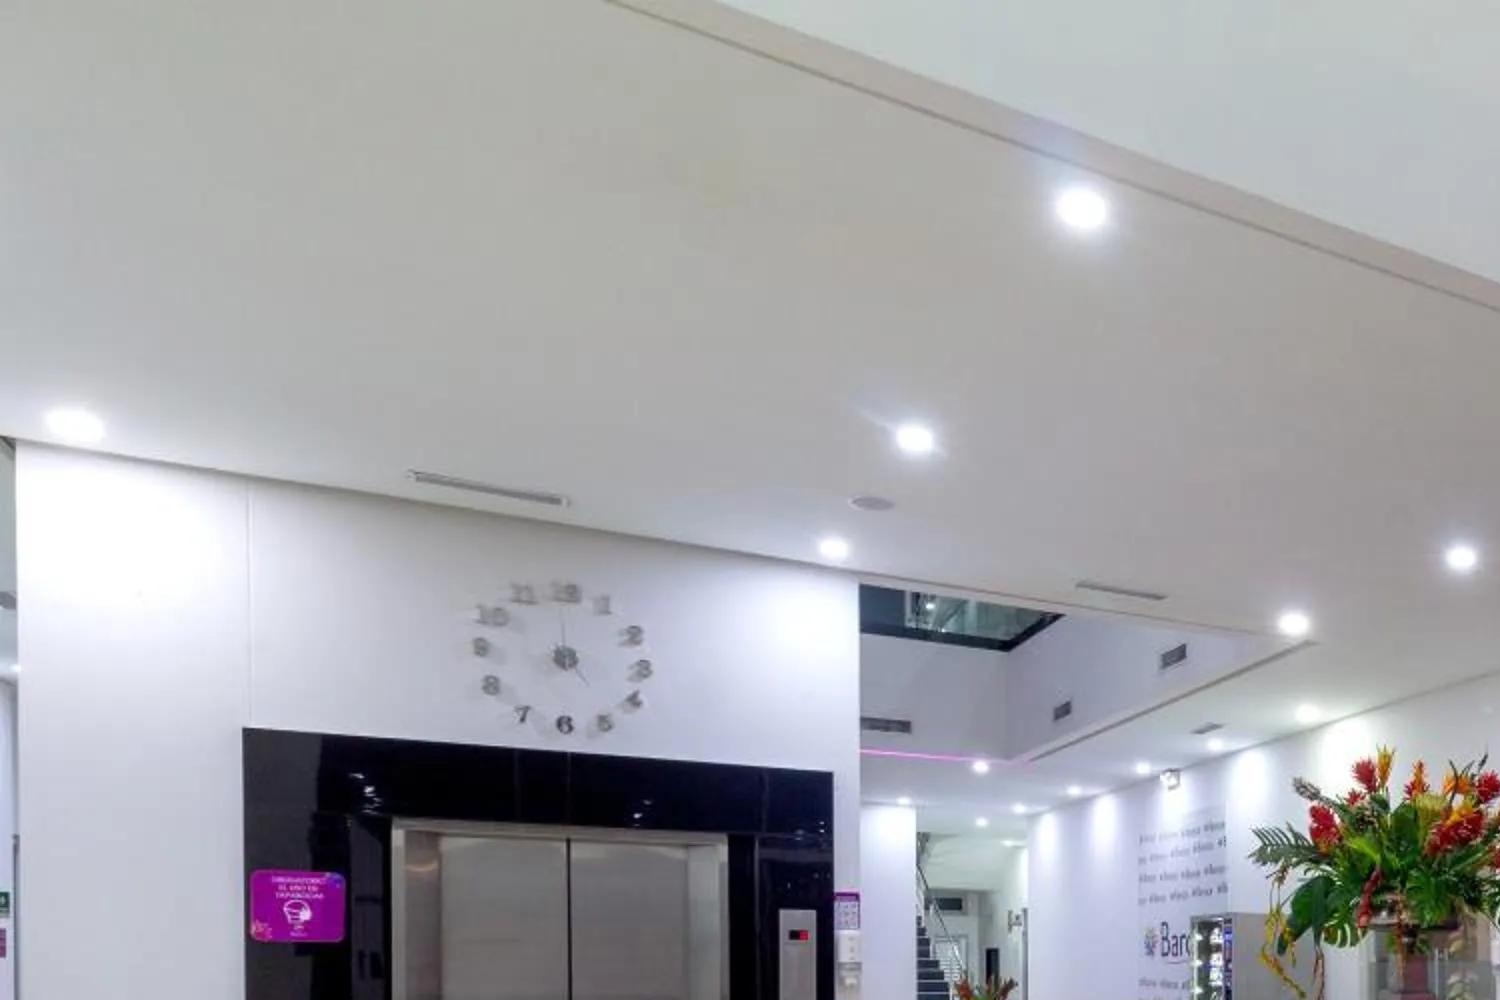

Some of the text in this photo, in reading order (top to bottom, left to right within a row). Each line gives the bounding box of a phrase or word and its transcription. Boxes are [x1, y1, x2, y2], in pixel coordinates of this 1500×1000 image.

[621, 625, 644, 646] 2
[482, 674, 500, 696] 8
[514, 705, 532, 724] 7
[597, 713, 614, 732] 5
[556, 715, 574, 734] 6
